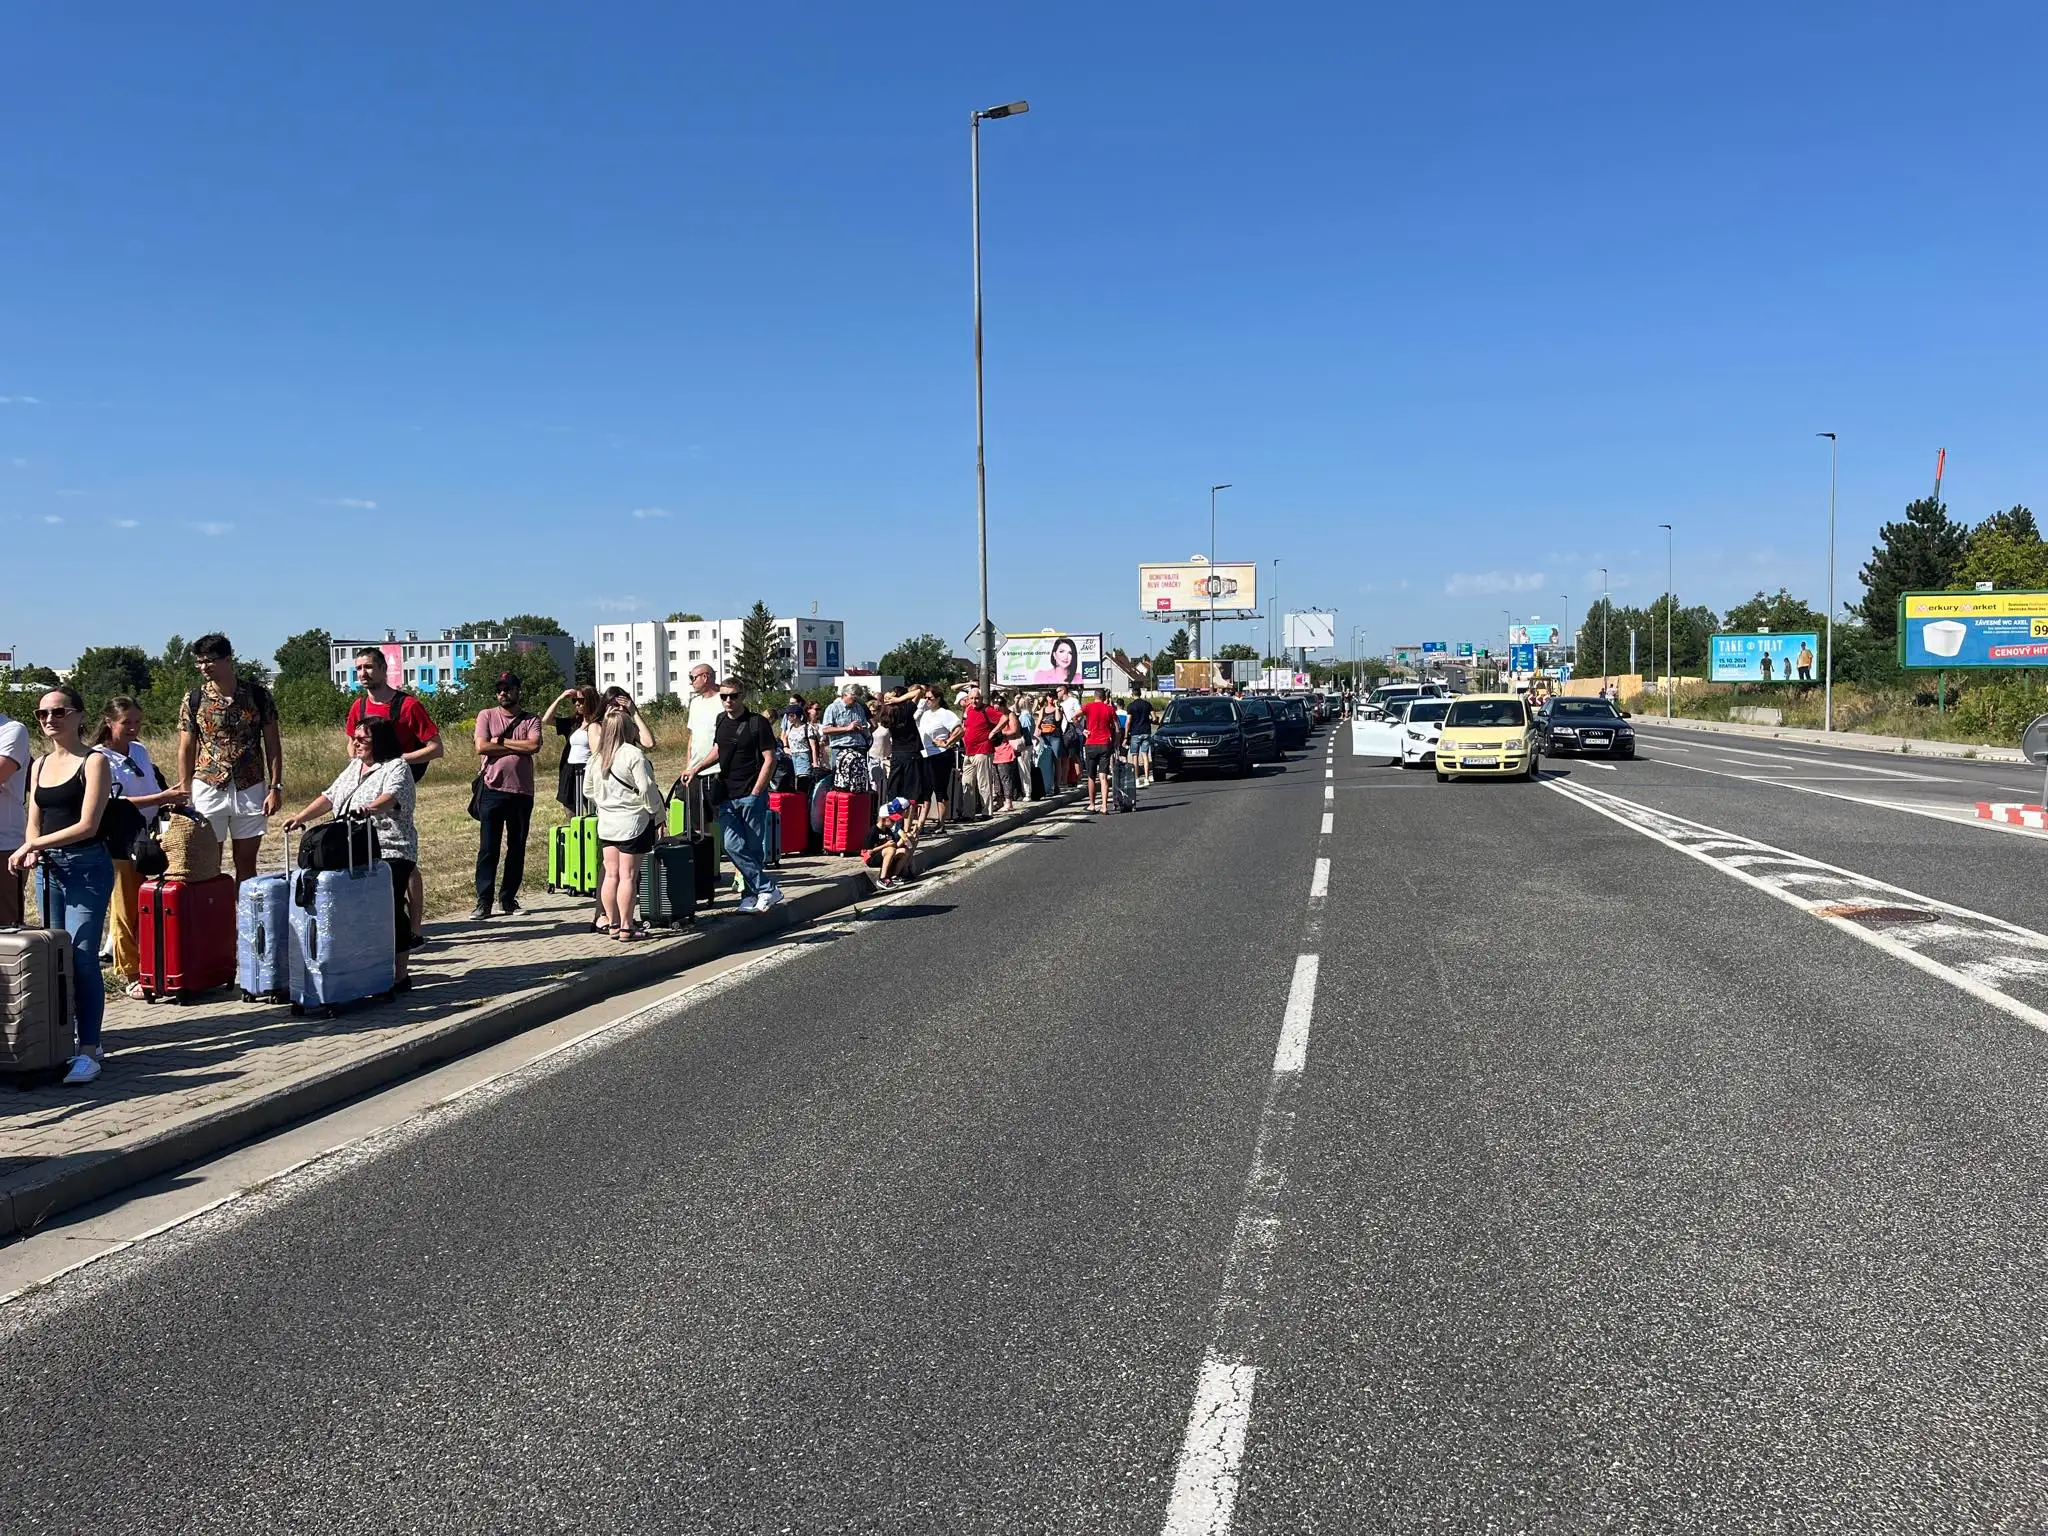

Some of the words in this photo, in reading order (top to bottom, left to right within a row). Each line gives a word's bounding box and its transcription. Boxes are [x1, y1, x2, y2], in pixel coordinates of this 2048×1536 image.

[1917, 604, 1959, 612] Merkury
[1960, 603, 1997, 612] Market
[1719, 640, 1744, 652] TAKE
[1758, 639, 1784, 652] THAT
[1995, 646, 2030, 657] CENOVÝ
